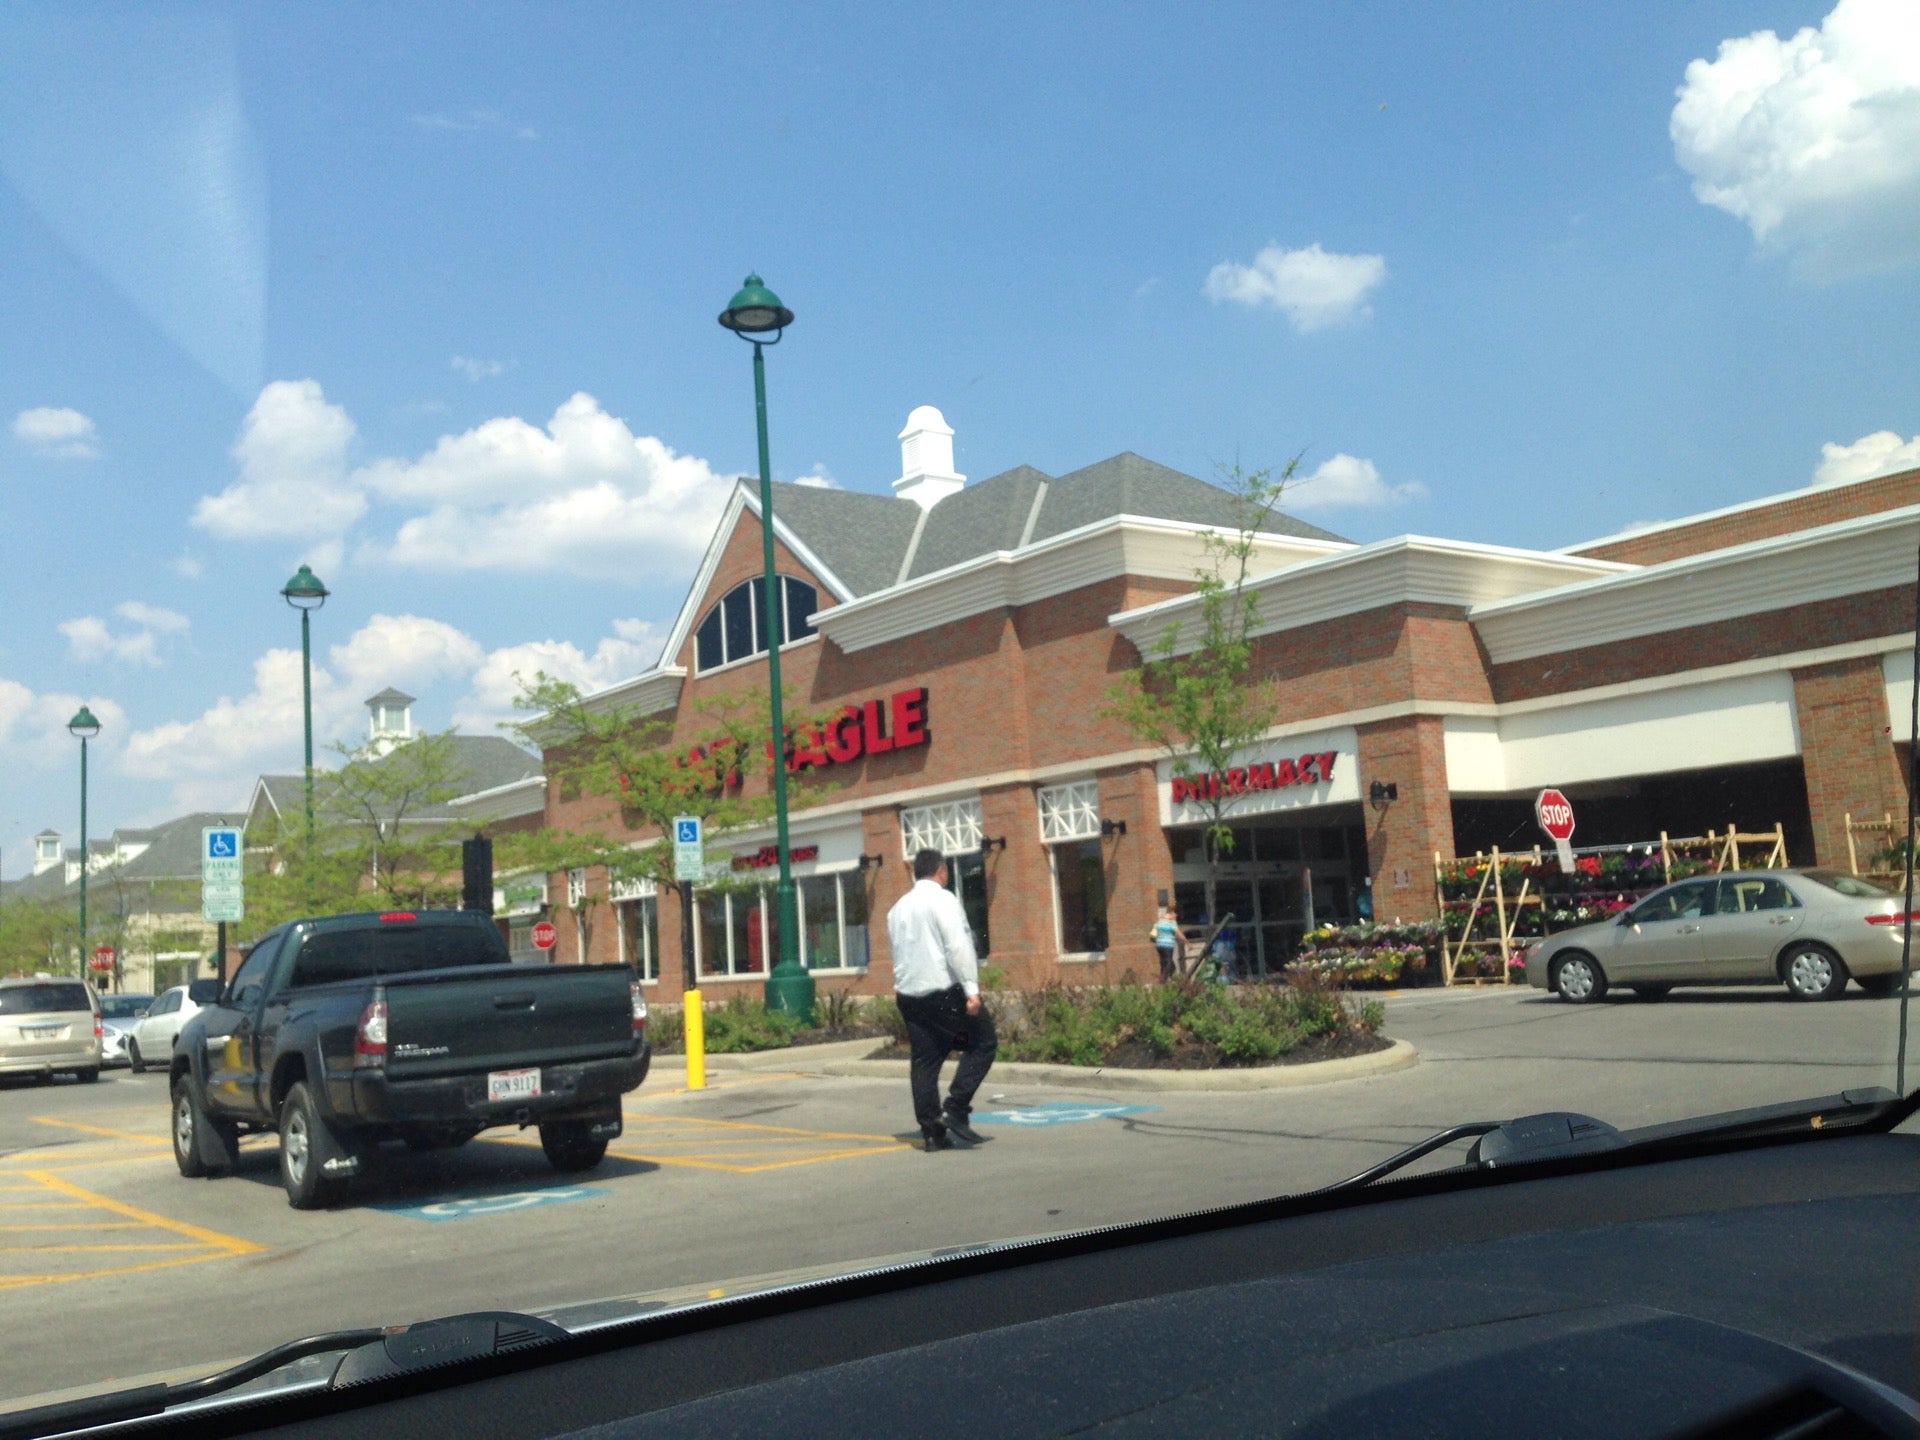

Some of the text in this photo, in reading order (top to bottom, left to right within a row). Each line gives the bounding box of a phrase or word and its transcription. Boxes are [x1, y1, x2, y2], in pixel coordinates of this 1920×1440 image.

[1541, 804, 1571, 826] STOP
[206, 860, 239, 869] PARKING
[533, 929, 556, 941] STOP
[89, 951, 115, 965] STOP
[512, 1075, 537, 1091] 9117
